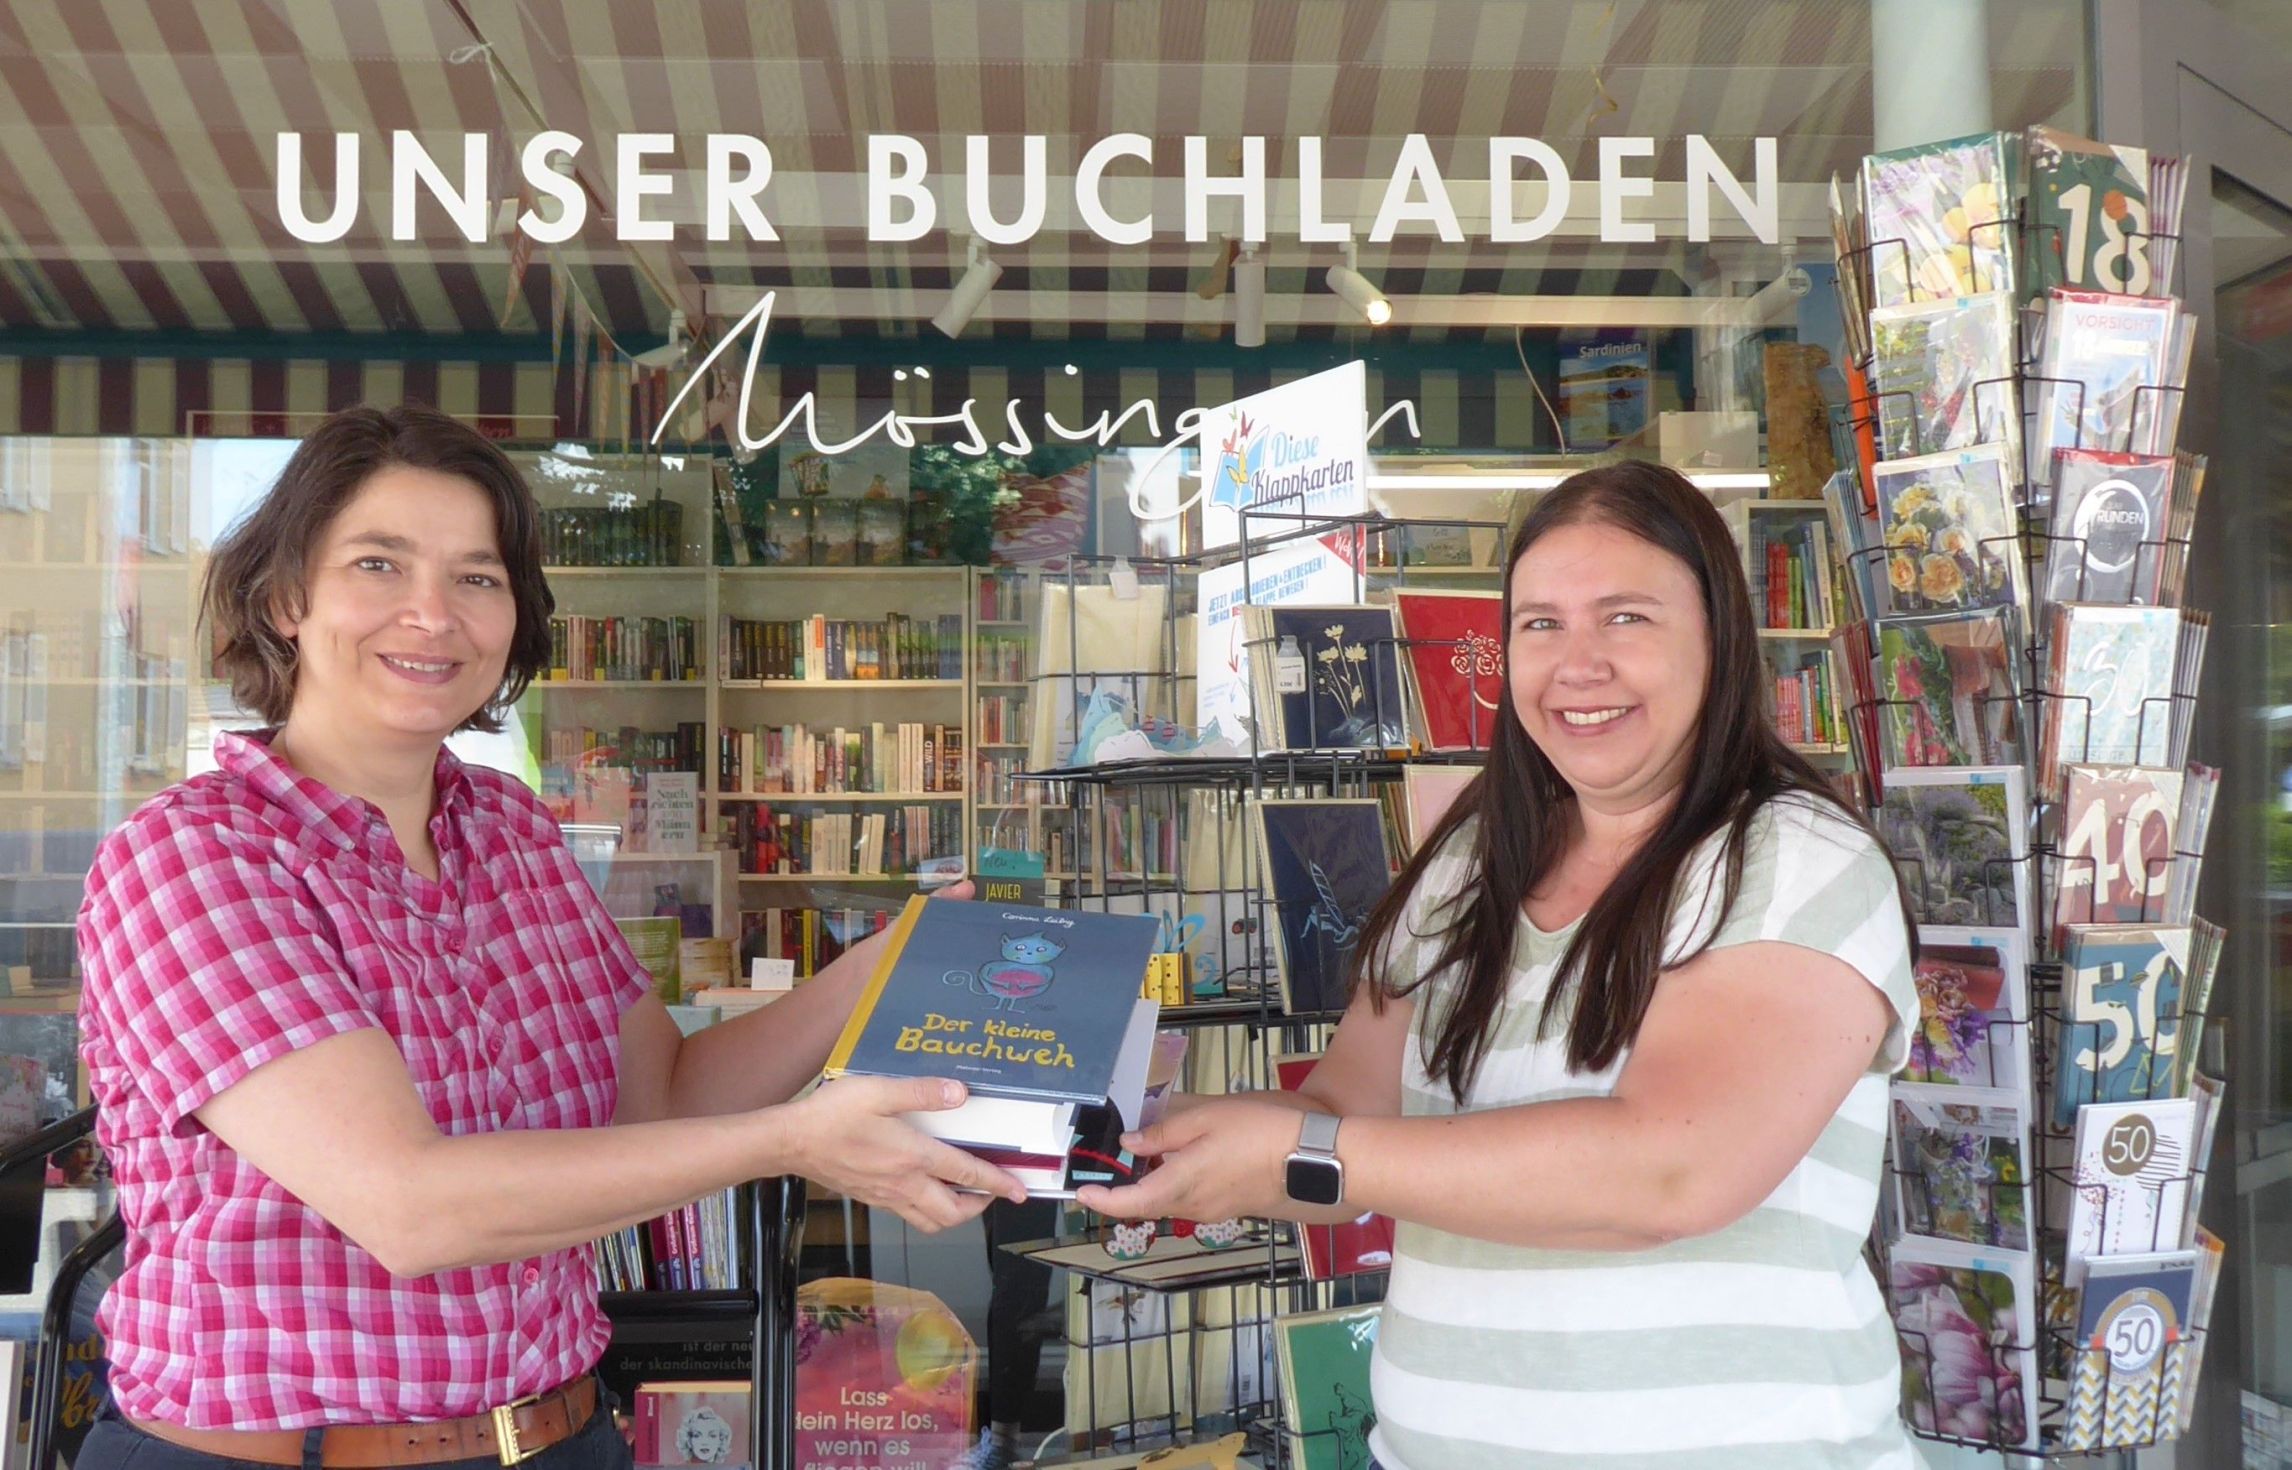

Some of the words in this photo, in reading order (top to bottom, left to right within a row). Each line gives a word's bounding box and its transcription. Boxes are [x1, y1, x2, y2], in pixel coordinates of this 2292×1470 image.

[277, 130, 780, 244] UNSER
[868, 132, 1779, 246] BUCHLADEN
[2058, 183, 2150, 297] 18
[2074, 313, 2155, 331] VORSICHT
[1579, 342, 1642, 360] Sardinien
[651, 290, 1421, 521] Mössingn
[1271, 431, 1320, 468] Diese
[1251, 458, 1354, 507] Klappkarten
[2062, 792, 2173, 905] 40
[985, 881, 1021, 902] JAVIER
[924, 1012, 974, 1034] Der
[983, 1018, 1057, 1043] kleine
[2075, 948, 2178, 1072] 50
[894, 1026, 1076, 1069] Bauchweh
[2107, 1125, 2151, 1165] 50
[2114, 1317, 2155, 1358] 50
[840, 1387, 889, 1407] Lass
[845, 1411, 894, 1431] Herz
[901, 1410, 939, 1432] los,
[814, 1437, 877, 1456] wenn
[884, 1438, 911, 1456] es
